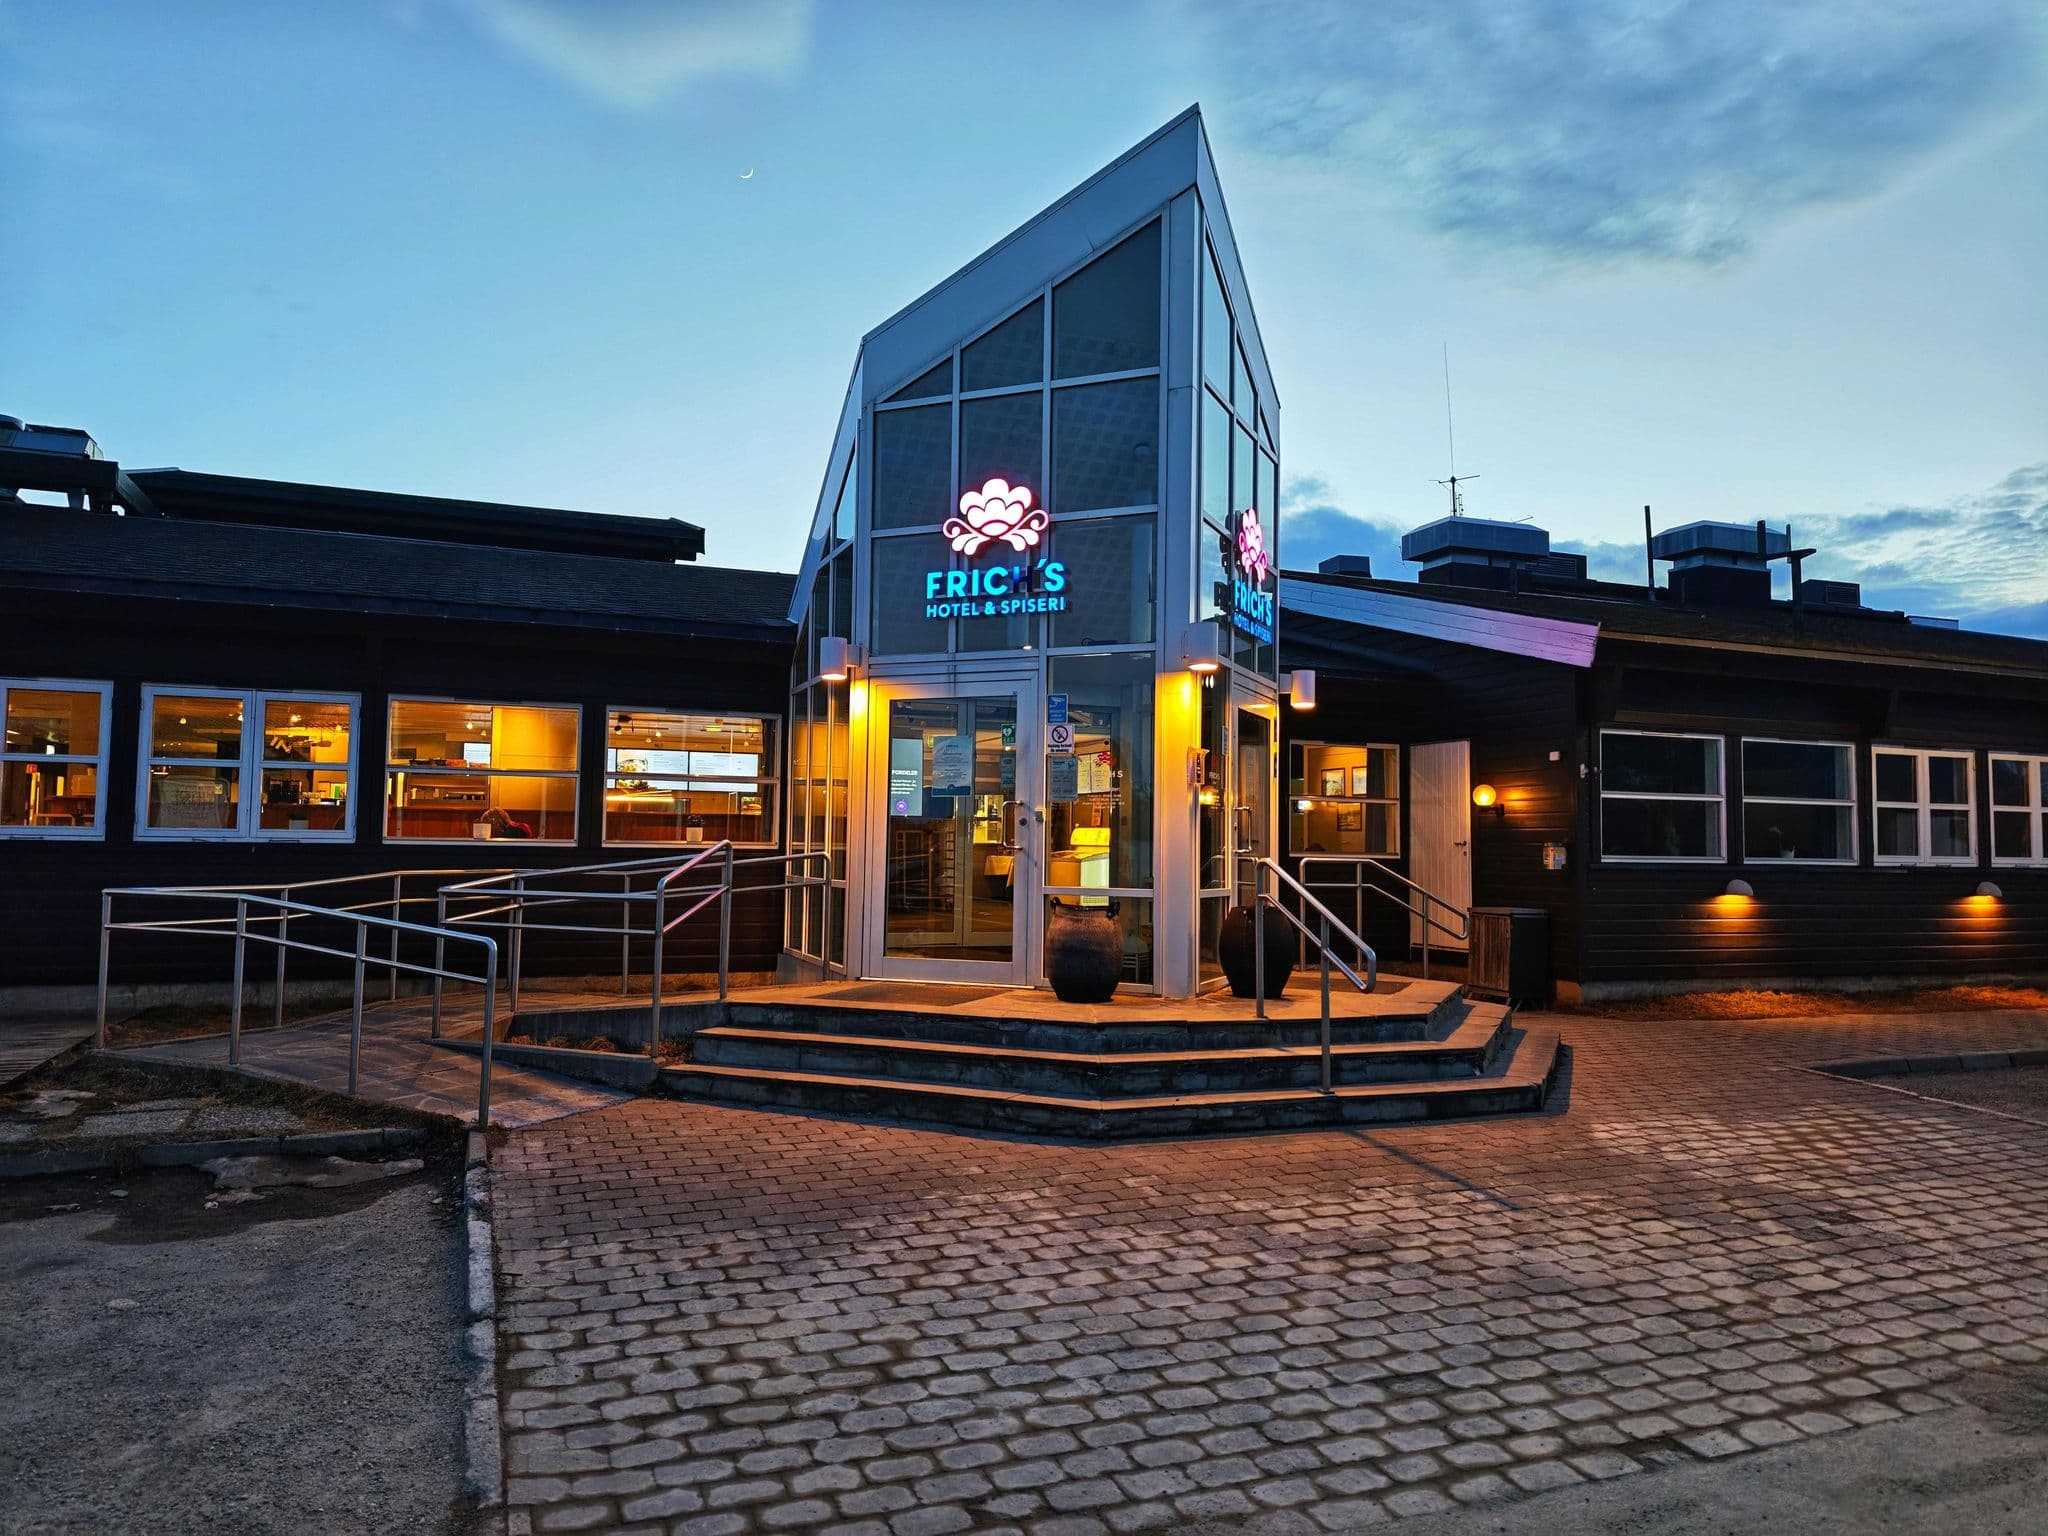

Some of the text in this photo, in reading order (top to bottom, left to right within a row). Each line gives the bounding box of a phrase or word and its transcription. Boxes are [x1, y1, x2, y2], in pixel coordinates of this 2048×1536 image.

[926, 558, 1065, 599] FRICH'S
[926, 597, 1065, 618] HOTEL & SPISERI
